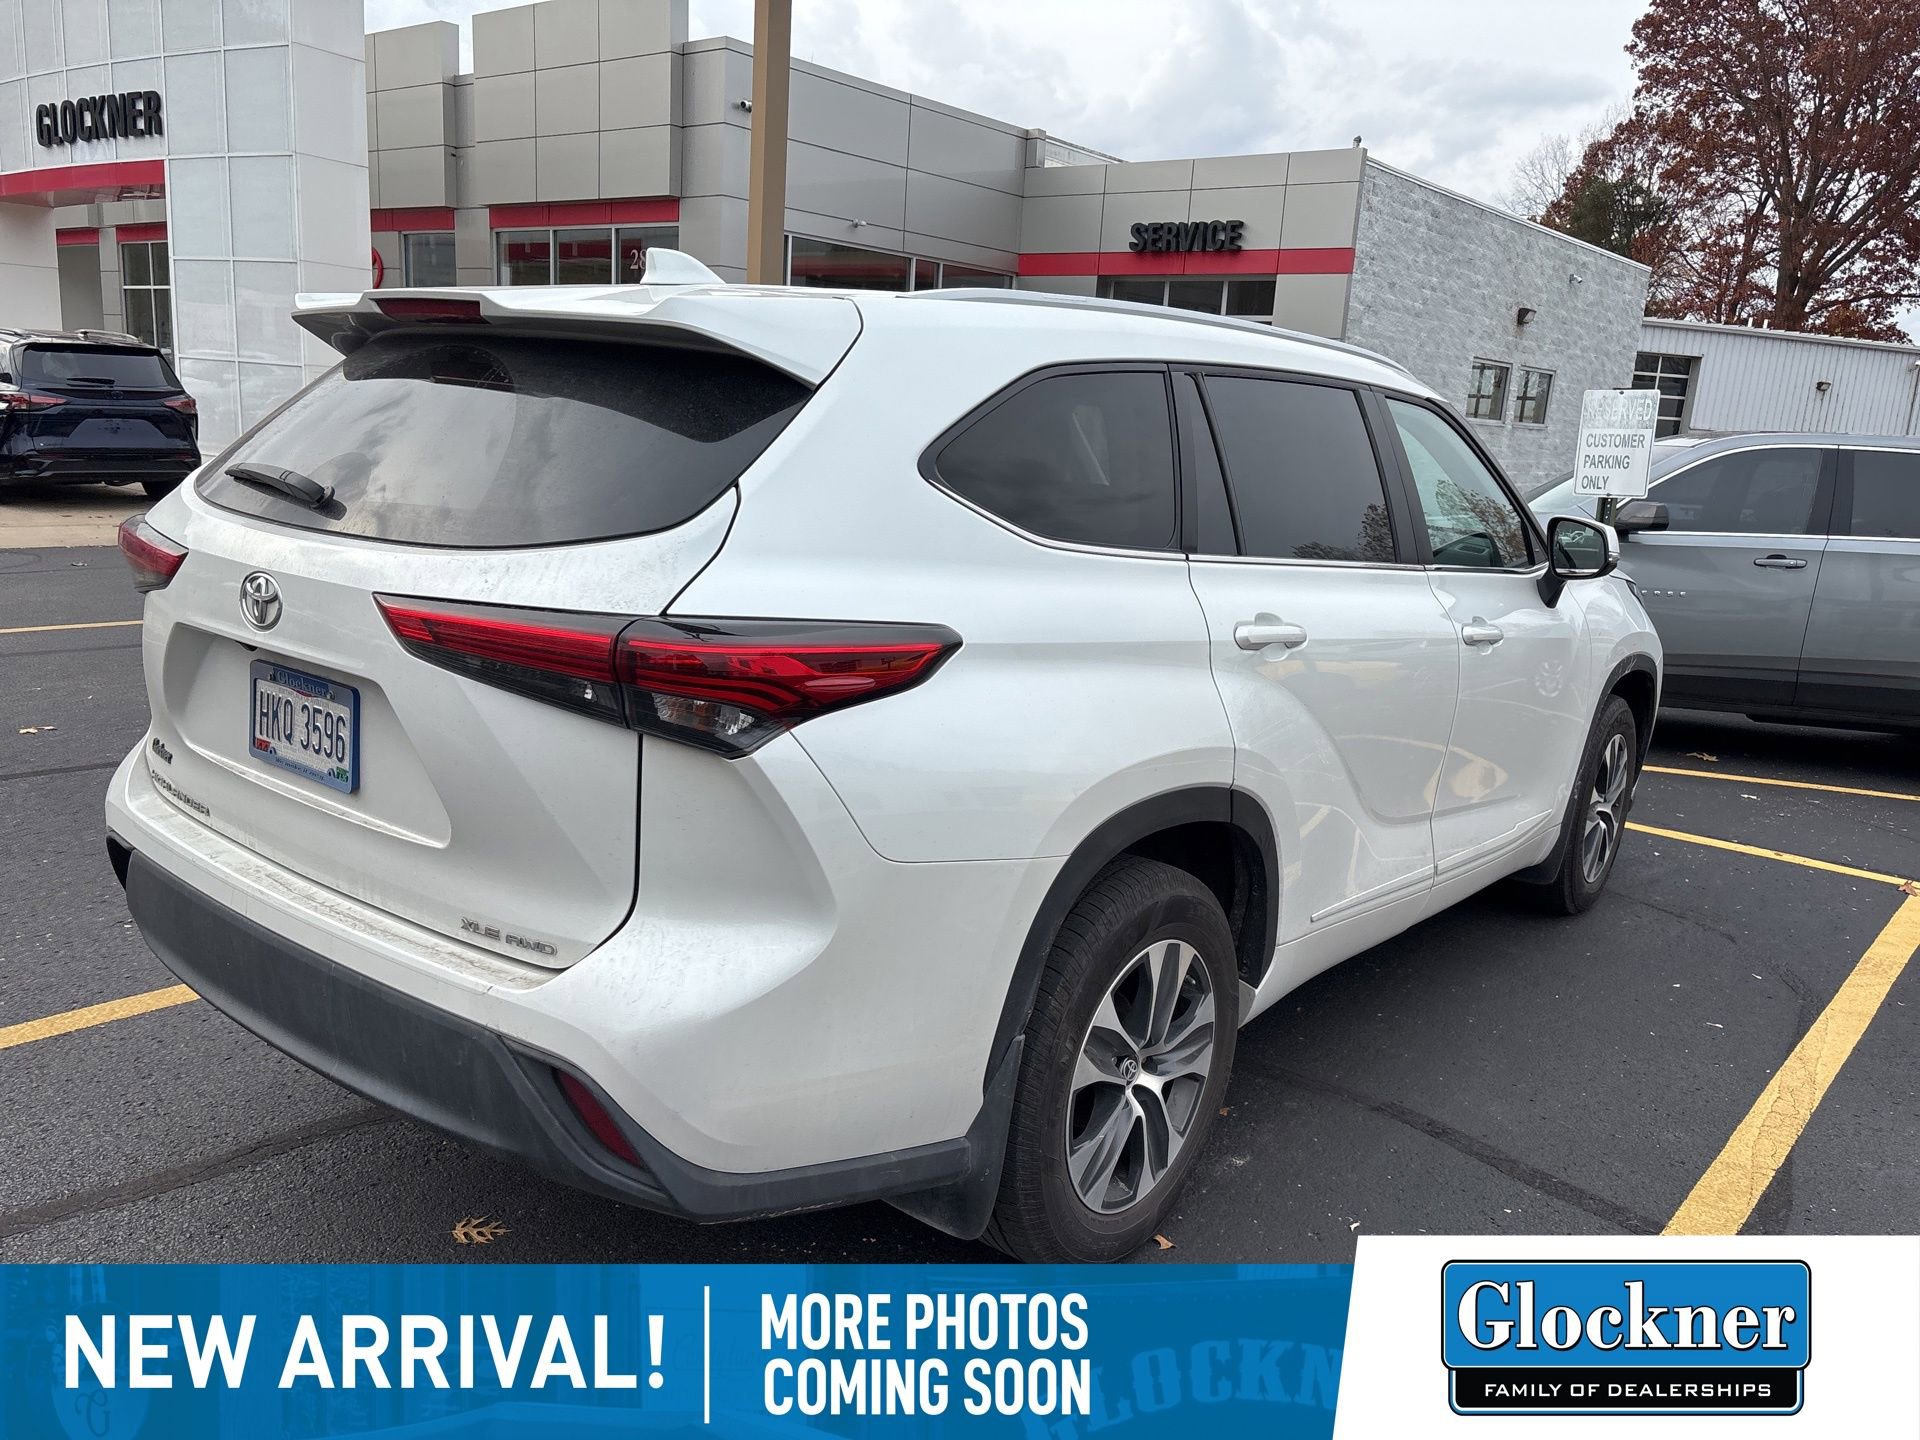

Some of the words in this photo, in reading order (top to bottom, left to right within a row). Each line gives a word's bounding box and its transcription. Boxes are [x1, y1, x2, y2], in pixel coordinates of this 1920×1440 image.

[36, 90, 163, 148] GLOCKNER
[1129, 220, 1244, 252] SERVICE
[1586, 433, 1646, 449] CUSTOMER
[1583, 454, 1631, 470] PARKING
[1581, 475, 1610, 490] ONLY
[259, 690, 294, 745] HKQ
[300, 702, 346, 763] 3596
[461, 916, 501, 941] XLE
[505, 933, 558, 956] AWD
